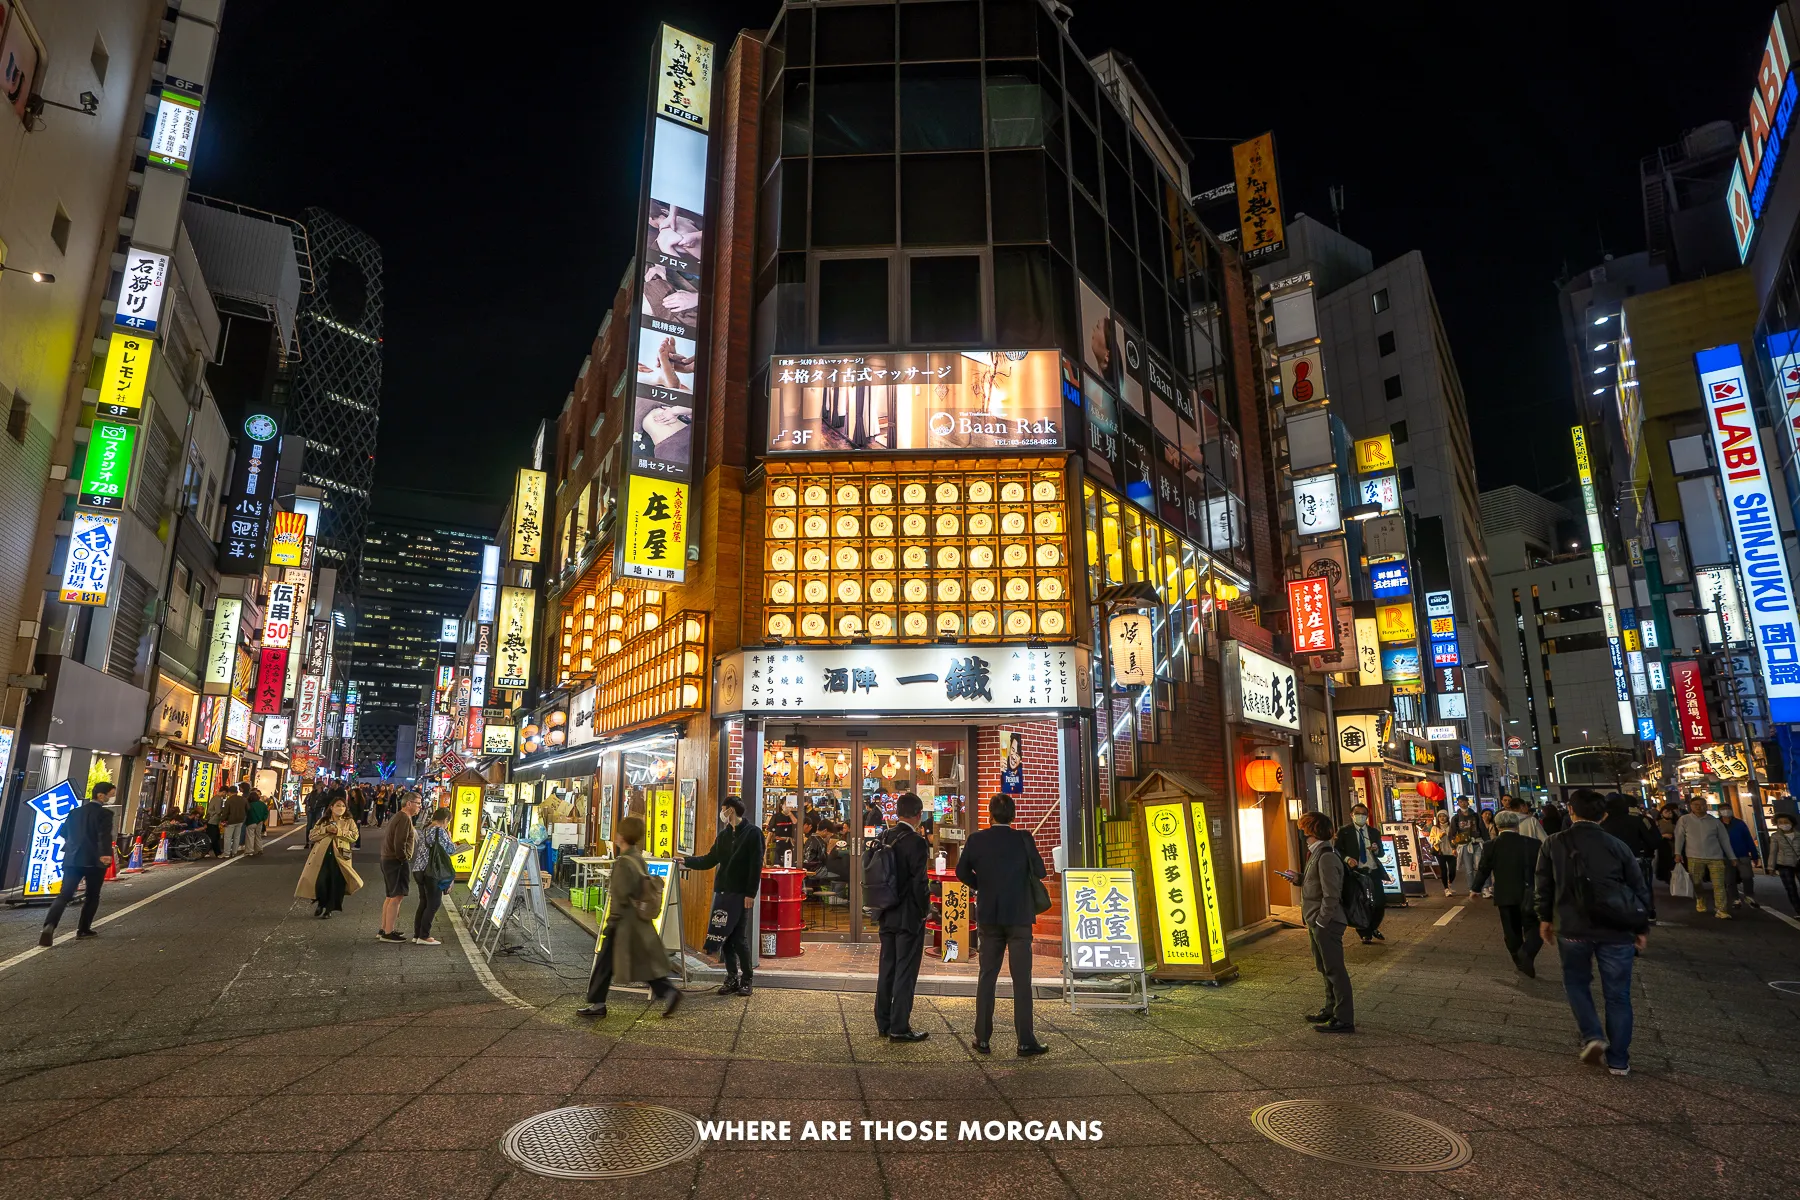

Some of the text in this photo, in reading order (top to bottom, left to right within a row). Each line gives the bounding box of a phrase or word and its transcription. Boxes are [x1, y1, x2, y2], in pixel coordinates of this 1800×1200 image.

[175, 79, 194, 90] 6F
[1739, 9, 1790, 195] LABI
[162, 156, 176, 165] 6F
[659, 254, 688, 269] アロマ
[128, 258, 155, 313] 石狩川
[125, 317, 146, 328] 4F
[651, 319, 685, 336] 眼精疲労
[116, 351, 136, 404] レモン社
[778, 365, 952, 384] 本格タイ古式マッサージ
[1149, 361, 1195, 421] Baan Rak
[110, 405, 128, 416] 3F
[651, 388, 678, 401] リフレ
[791, 429, 813, 446] 3F
[959, 416, 1057, 435] Baan Rak
[98, 440, 118, 482] スタジオ
[638, 458, 684, 474] 腸セラピー
[89, 481, 119, 495] 728
[92, 494, 112, 506] 3F
[642, 490, 672, 560] 庄屋
[671, 486, 684, 544] 大衆居酒屋
[1298, 492, 1317, 527] ねぎし
[1714, 402, 1790, 613] LABI SHINJUKU
[67, 560, 88, 590] 酒場
[271, 584, 294, 621] 伝串
[266, 622, 290, 640] 50
[478, 625, 490, 655] BAR
[1306, 611, 1327, 648] 庄屋
[1361, 645, 1377, 674] ねぎし
[1759, 621, 1800, 685] 西口館
[751, 655, 761, 707] 牛煮込み
[765, 655, 776, 707] 博多もつ鍋
[822, 665, 880, 695] 酒陣
[1012, 651, 1022, 704] 八海山
[1027, 651, 1038, 704] 会津ほまれ
[1043, 651, 1053, 704] レモンサワー
[1058, 651, 1069, 704] アサヒビール
[1681, 669, 1701, 720] ワインの酒場。
[299, 679, 314, 722] カラオケ
[456, 687, 469, 727] やきとん
[1271, 671, 1298, 724] 庄屋
[295, 727, 313, 739] 24h
[33, 835, 50, 862] 酒場
[1075, 886, 1130, 914] 完全
[1160, 843, 1191, 949] 博多もつ鍋
[1199, 841, 1220, 946] アサヒビール
[944, 889, 960, 938] 商い中
[1075, 913, 1132, 942] 個室
[1077, 945, 1111, 968] 2F
[1105, 959, 1136, 969] へどうぞ
